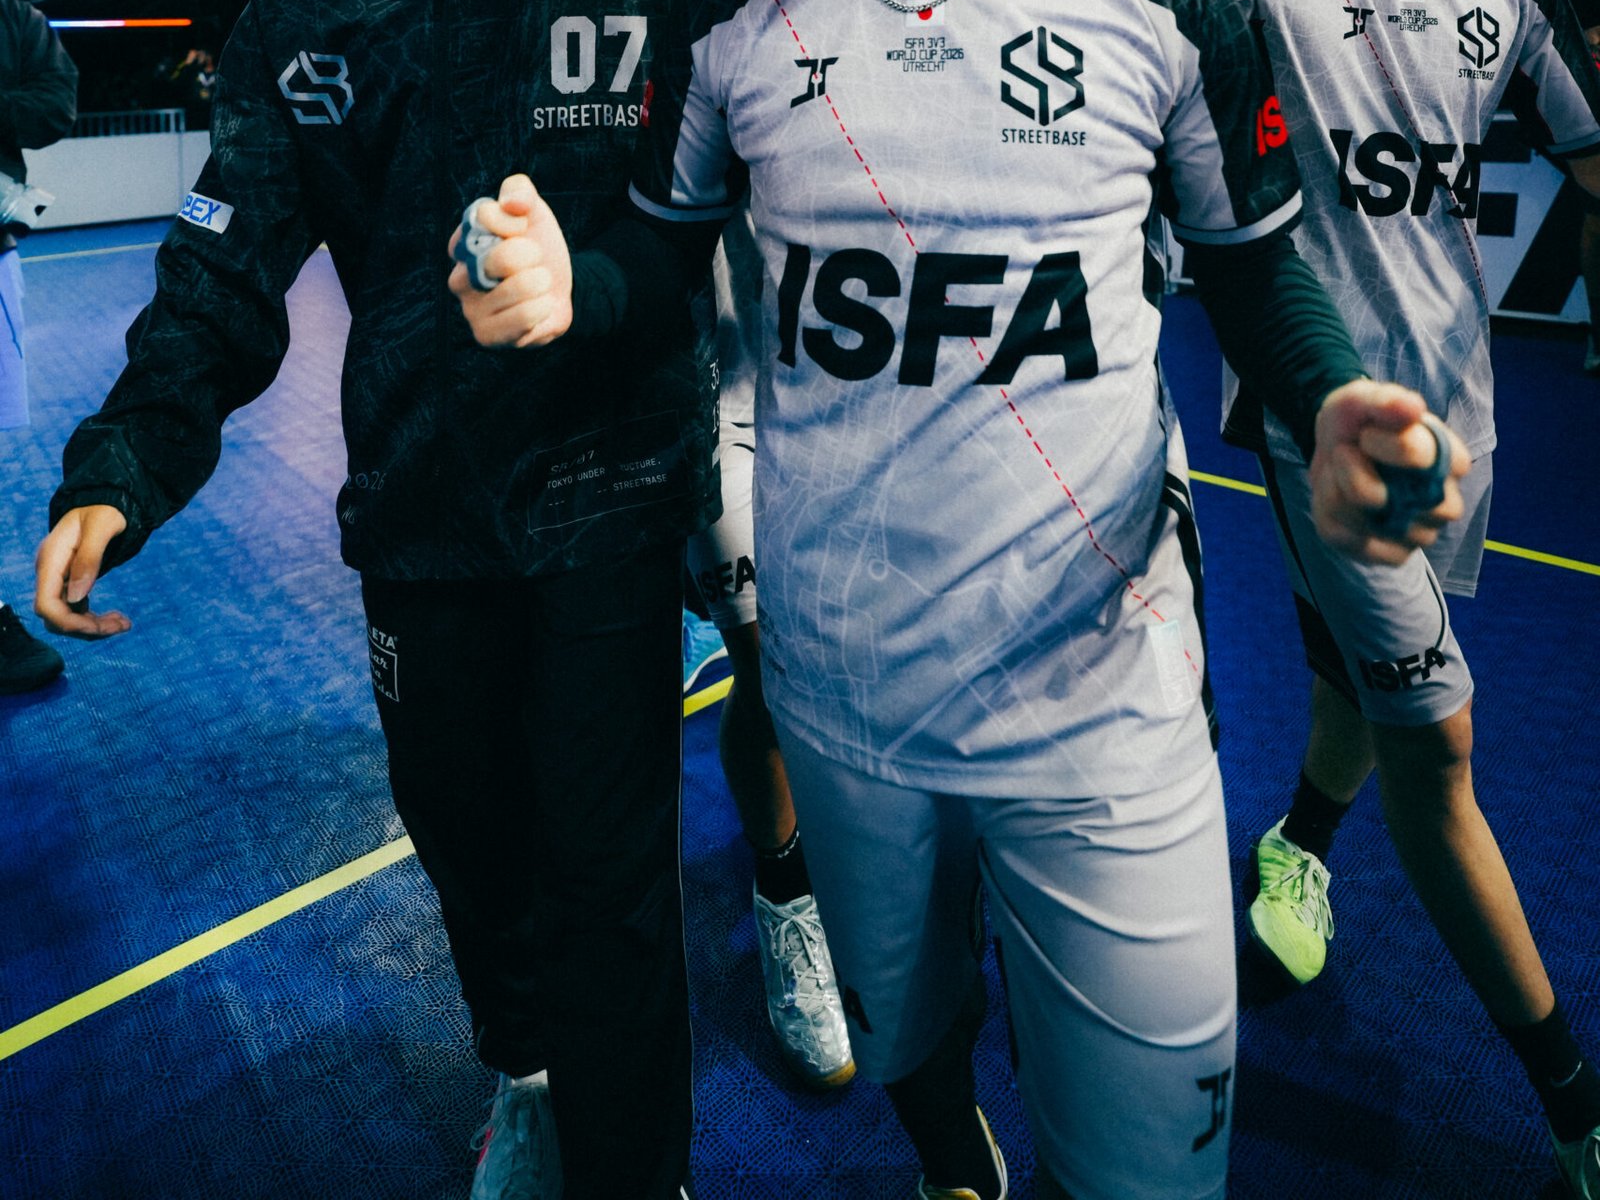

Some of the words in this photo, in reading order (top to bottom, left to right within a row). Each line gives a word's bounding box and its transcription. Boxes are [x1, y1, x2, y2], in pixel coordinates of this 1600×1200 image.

[927, 36, 945, 49] 3V3
[550, 15, 648, 95] 07
[886, 50, 917, 61] WORLD
[919, 49, 938, 61] CUP
[940, 48, 965, 60] 2026
[903, 61, 945, 72] UTRECHT
[1001, 128, 1087, 146] STREETBASE
[1329, 128, 1481, 219] ISFA
[776, 243, 1099, 387] ISFA
[547, 475, 573, 489] TOKYO
[612, 474, 668, 491] STREETBASE
